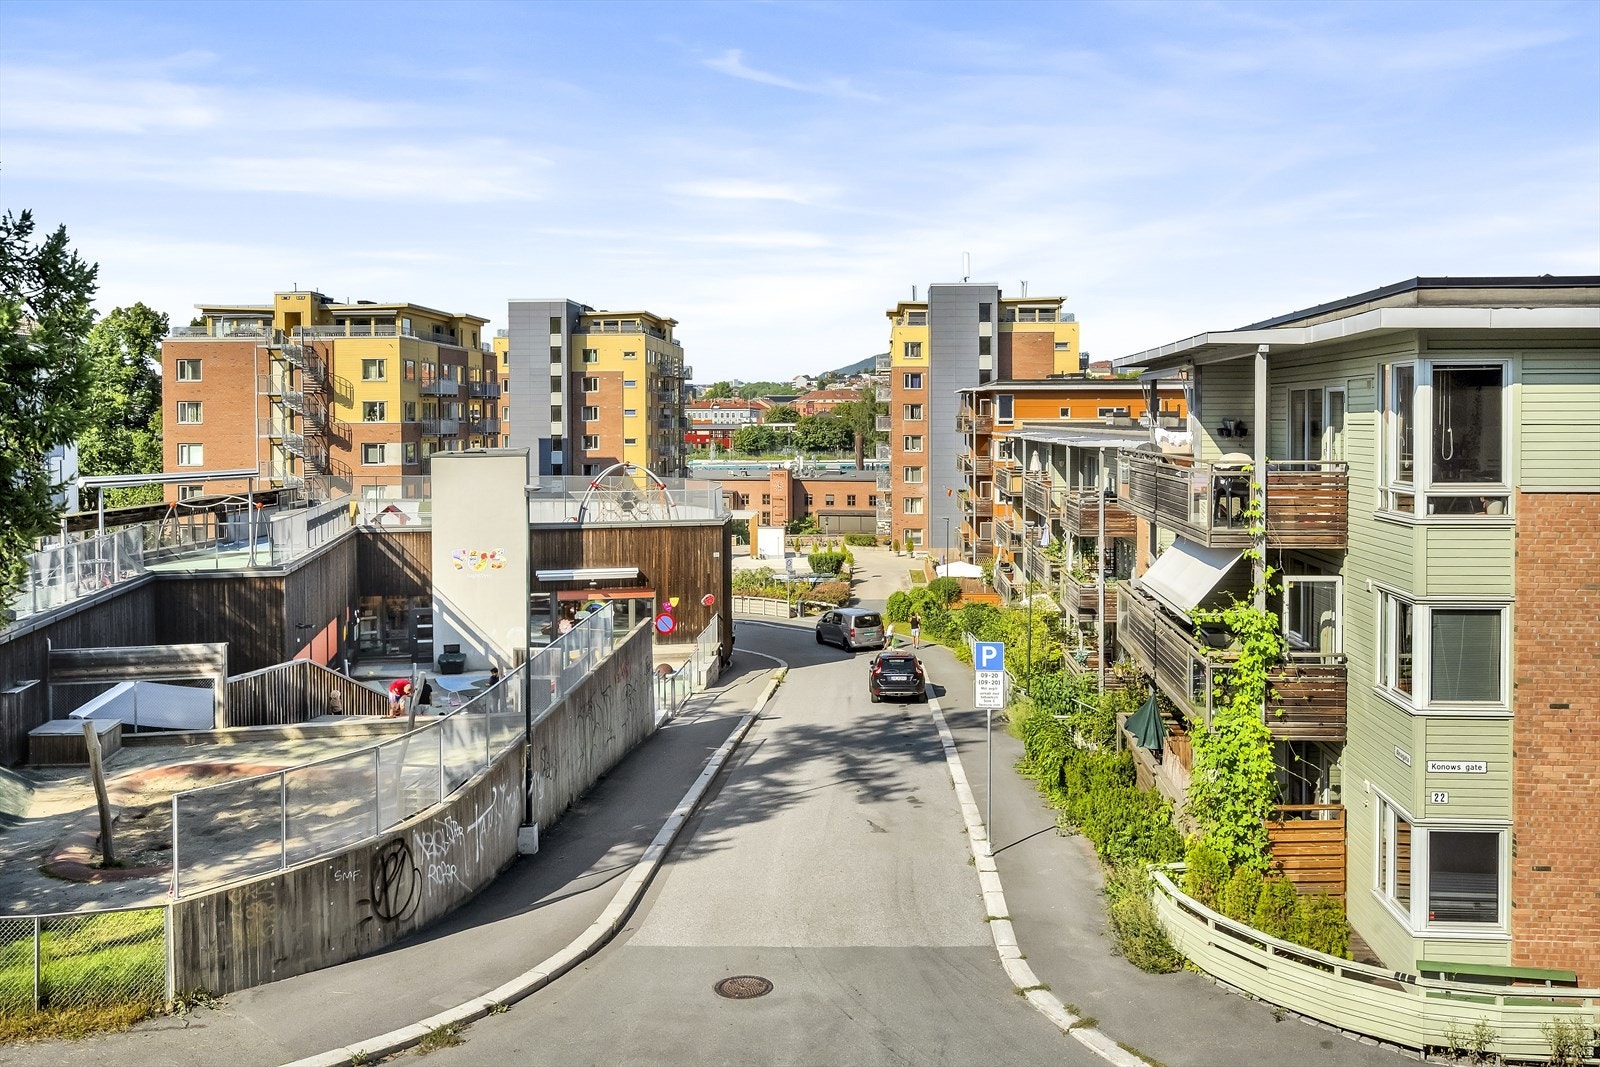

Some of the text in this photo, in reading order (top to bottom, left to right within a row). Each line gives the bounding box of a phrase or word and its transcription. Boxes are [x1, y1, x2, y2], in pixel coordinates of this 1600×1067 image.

[982, 645, 997, 667] P
[1431, 762, 1483, 772] Konows gate
[1434, 793, 1445, 803] 22
